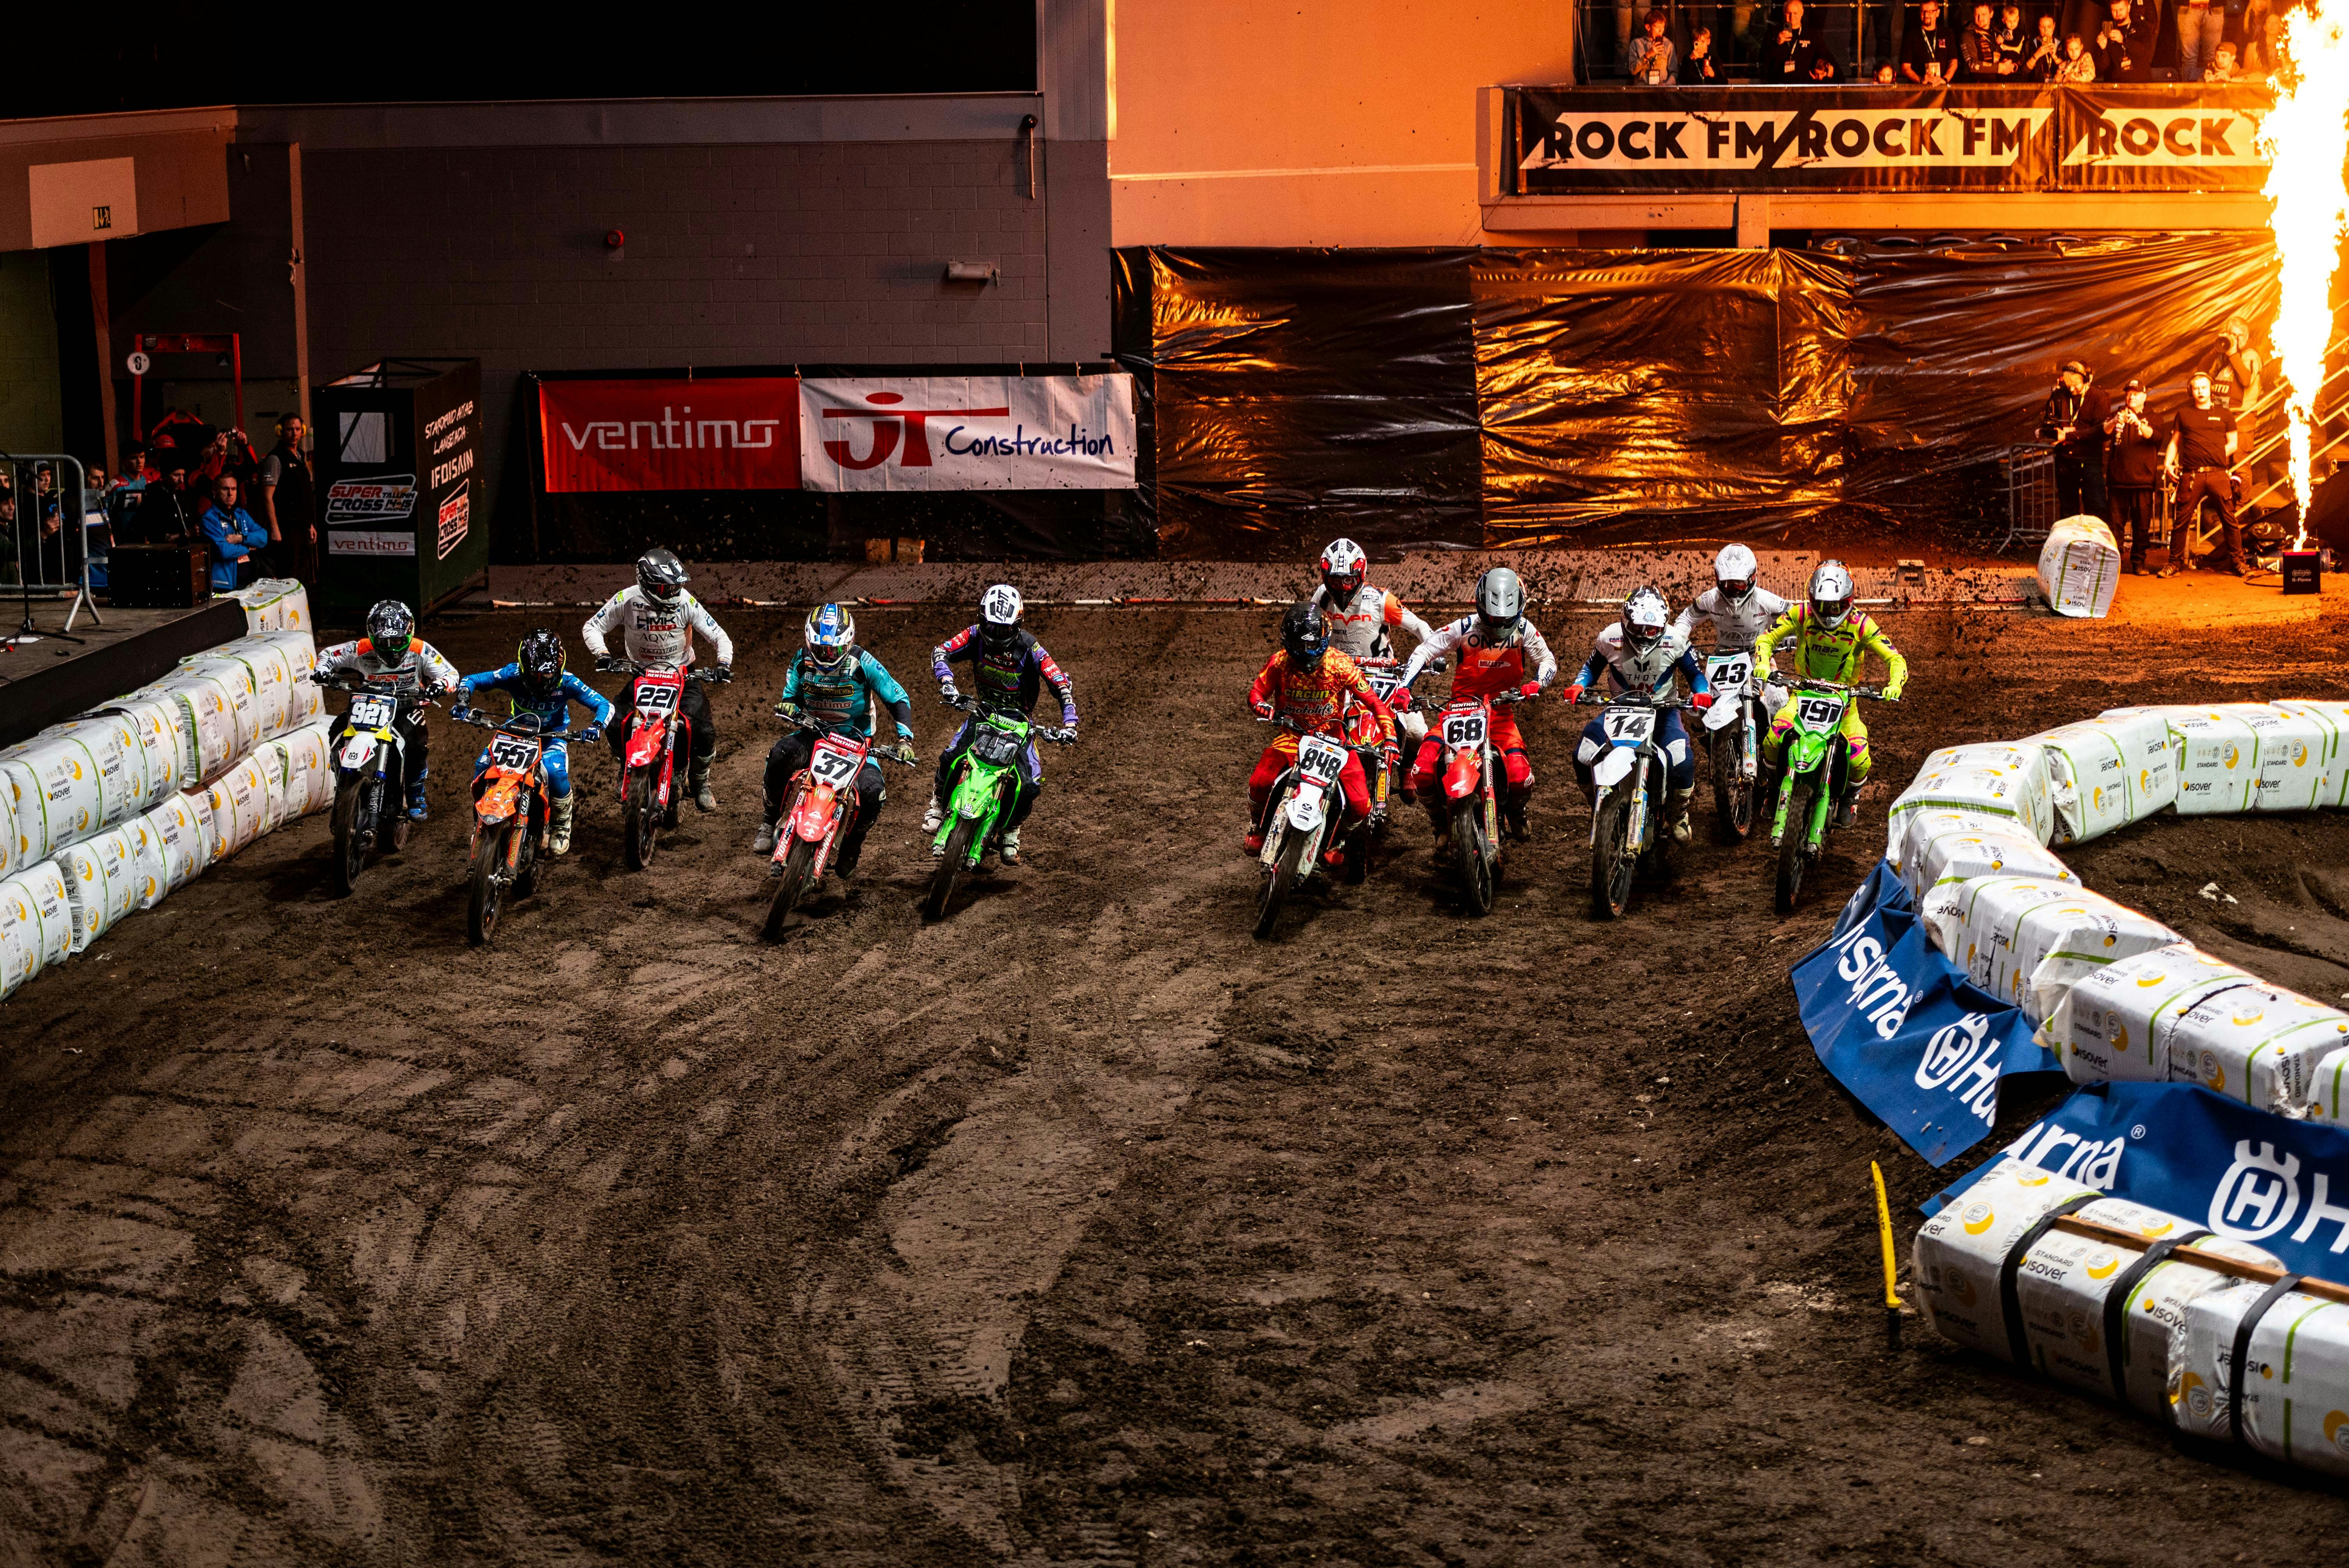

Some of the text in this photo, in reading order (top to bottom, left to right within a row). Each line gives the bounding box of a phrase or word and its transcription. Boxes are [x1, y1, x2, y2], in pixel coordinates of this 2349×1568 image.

[1543, 117, 2236, 160] ROCK FM ROCK FM ROCK
[561, 405, 780, 451] ventimo
[945, 423, 1114, 457] Construction
[329, 486, 383, 498] SUPER
[329, 498, 384, 511] CROSS
[440, 516, 458, 541] CROSS
[334, 537, 409, 551] ventimo
[637, 615, 676, 625] HMK
[640, 631, 675, 644] AQVA
[297, 673, 307, 683] isover
[1711, 663, 1747, 686] 43
[350, 702, 390, 727] 921
[1800, 699, 1843, 723] 191
[1447, 718, 1483, 744] 68
[1610, 715, 1652, 738] 14
[817, 742, 838, 752] ADDINOL
[830, 736, 858, 750] RENTHAL
[2148, 741, 2163, 755] isover
[493, 741, 538, 770] 551
[106, 763, 120, 776] isover
[813, 752, 857, 780] 37
[1300, 747, 1342, 780] 848
[2101, 759, 2117, 772] isover
[51, 778, 68, 789] STANDARD
[271, 773, 281, 784] isover
[53, 786, 71, 800] isover
[2106, 782, 2122, 791] STANDARD
[2189, 782, 2212, 791] isover
[239, 793, 250, 805] isover
[201, 814, 211, 825] isover
[57, 829, 73, 841] STANDARD
[167, 832, 179, 844] isover
[109, 864, 119, 878] isover
[46, 905, 58, 918] isover
[2074, 1022, 2102, 1039] STANDARD
[2078, 1048, 2108, 1066] isover
[2034, 1249, 2075, 1267] STANDARD
[2026, 1259, 2068, 1282] isover
